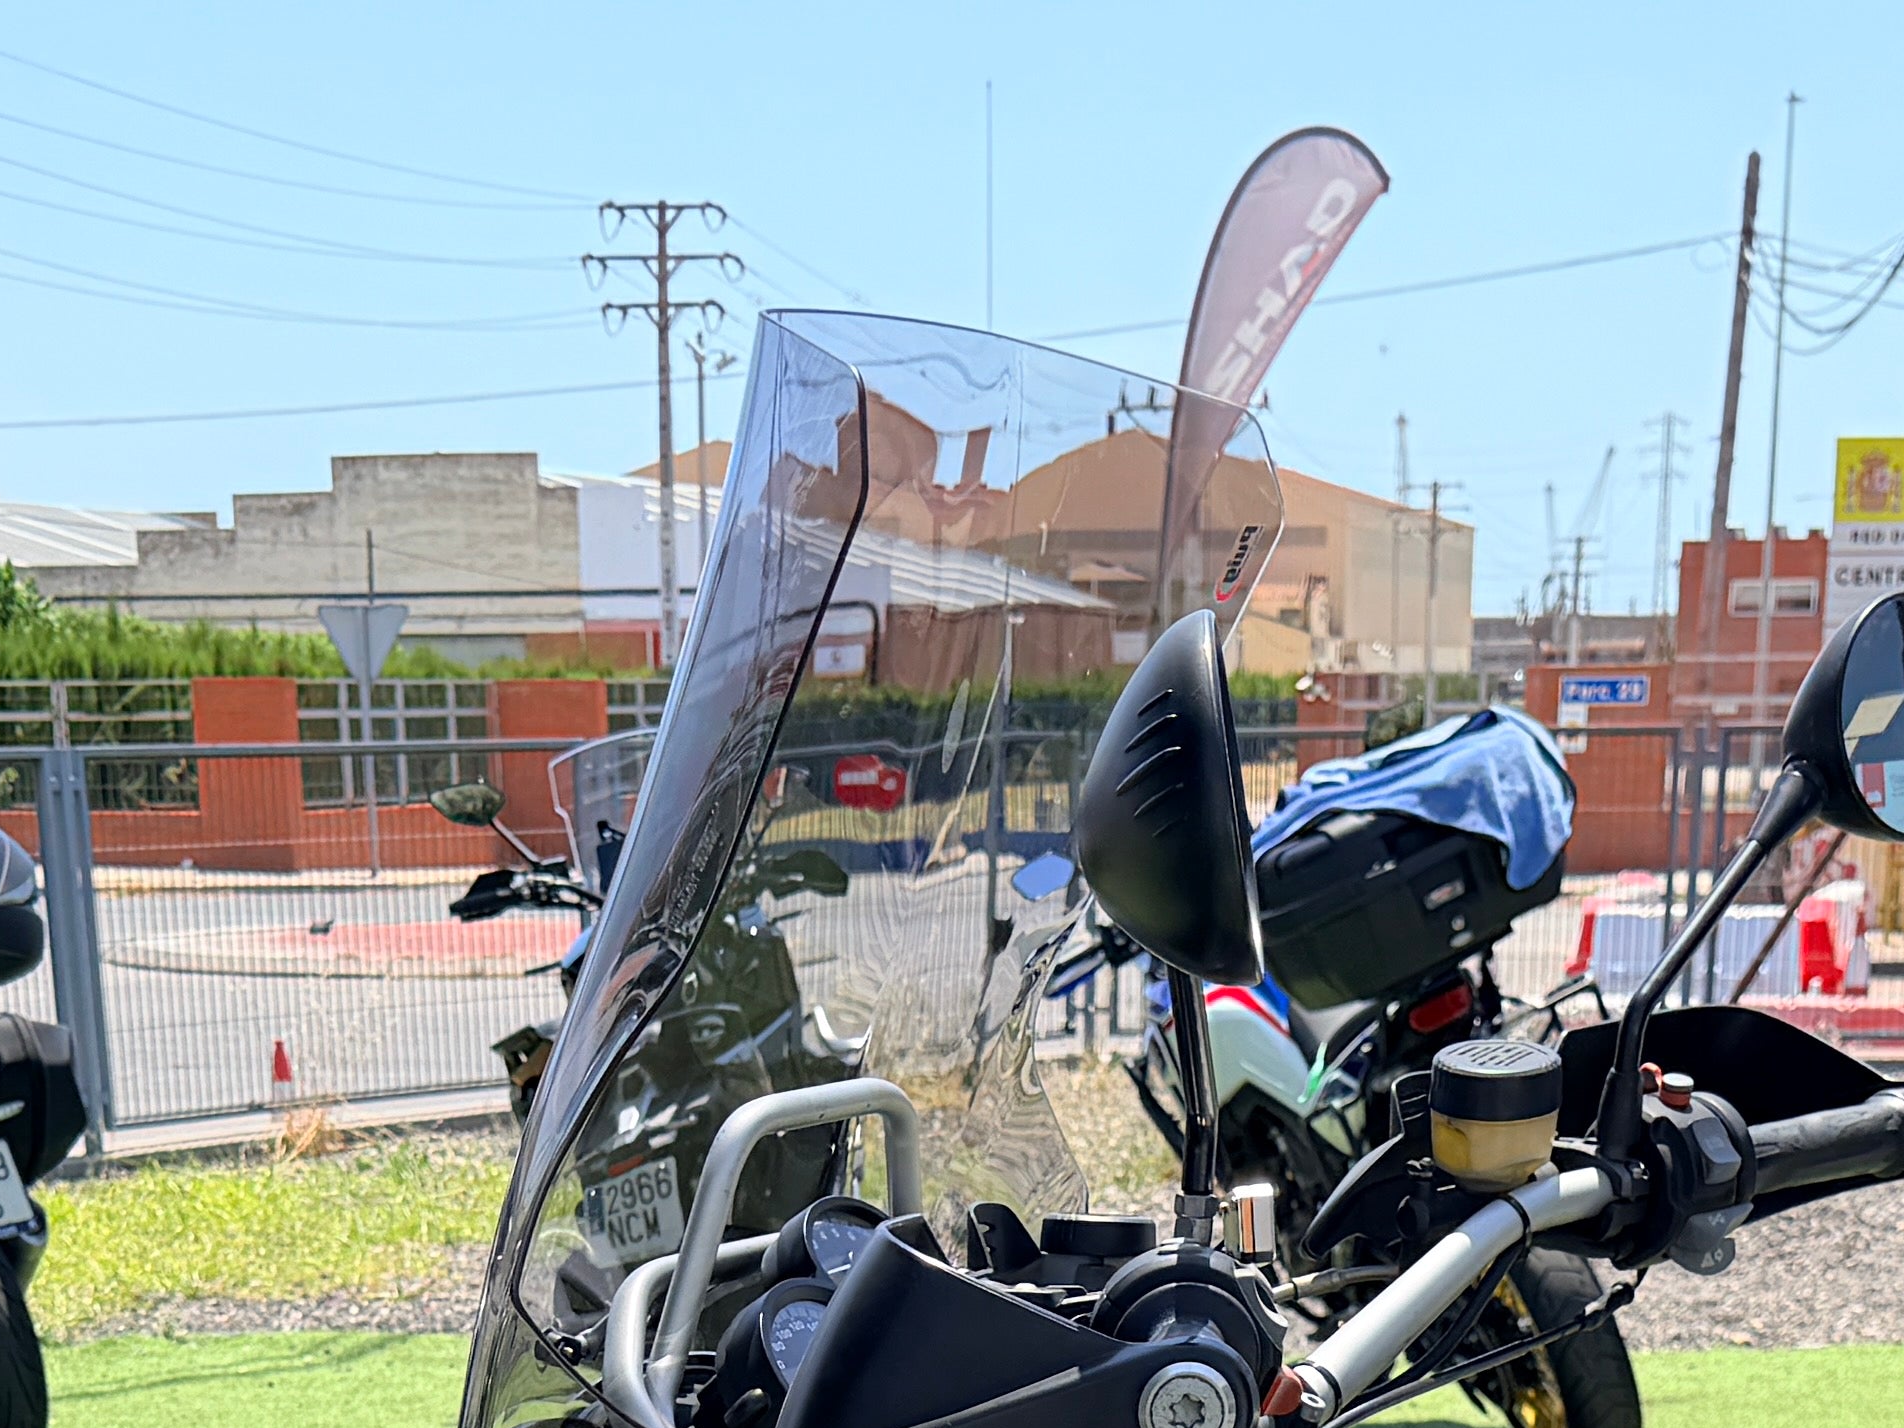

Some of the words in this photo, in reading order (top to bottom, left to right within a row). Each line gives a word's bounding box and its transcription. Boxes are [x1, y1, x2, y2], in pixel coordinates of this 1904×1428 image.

[1201, 177, 1359, 400] SHAD
[607, 1167, 672, 1216] 2966
[608, 1207, 661, 1248] NCM
